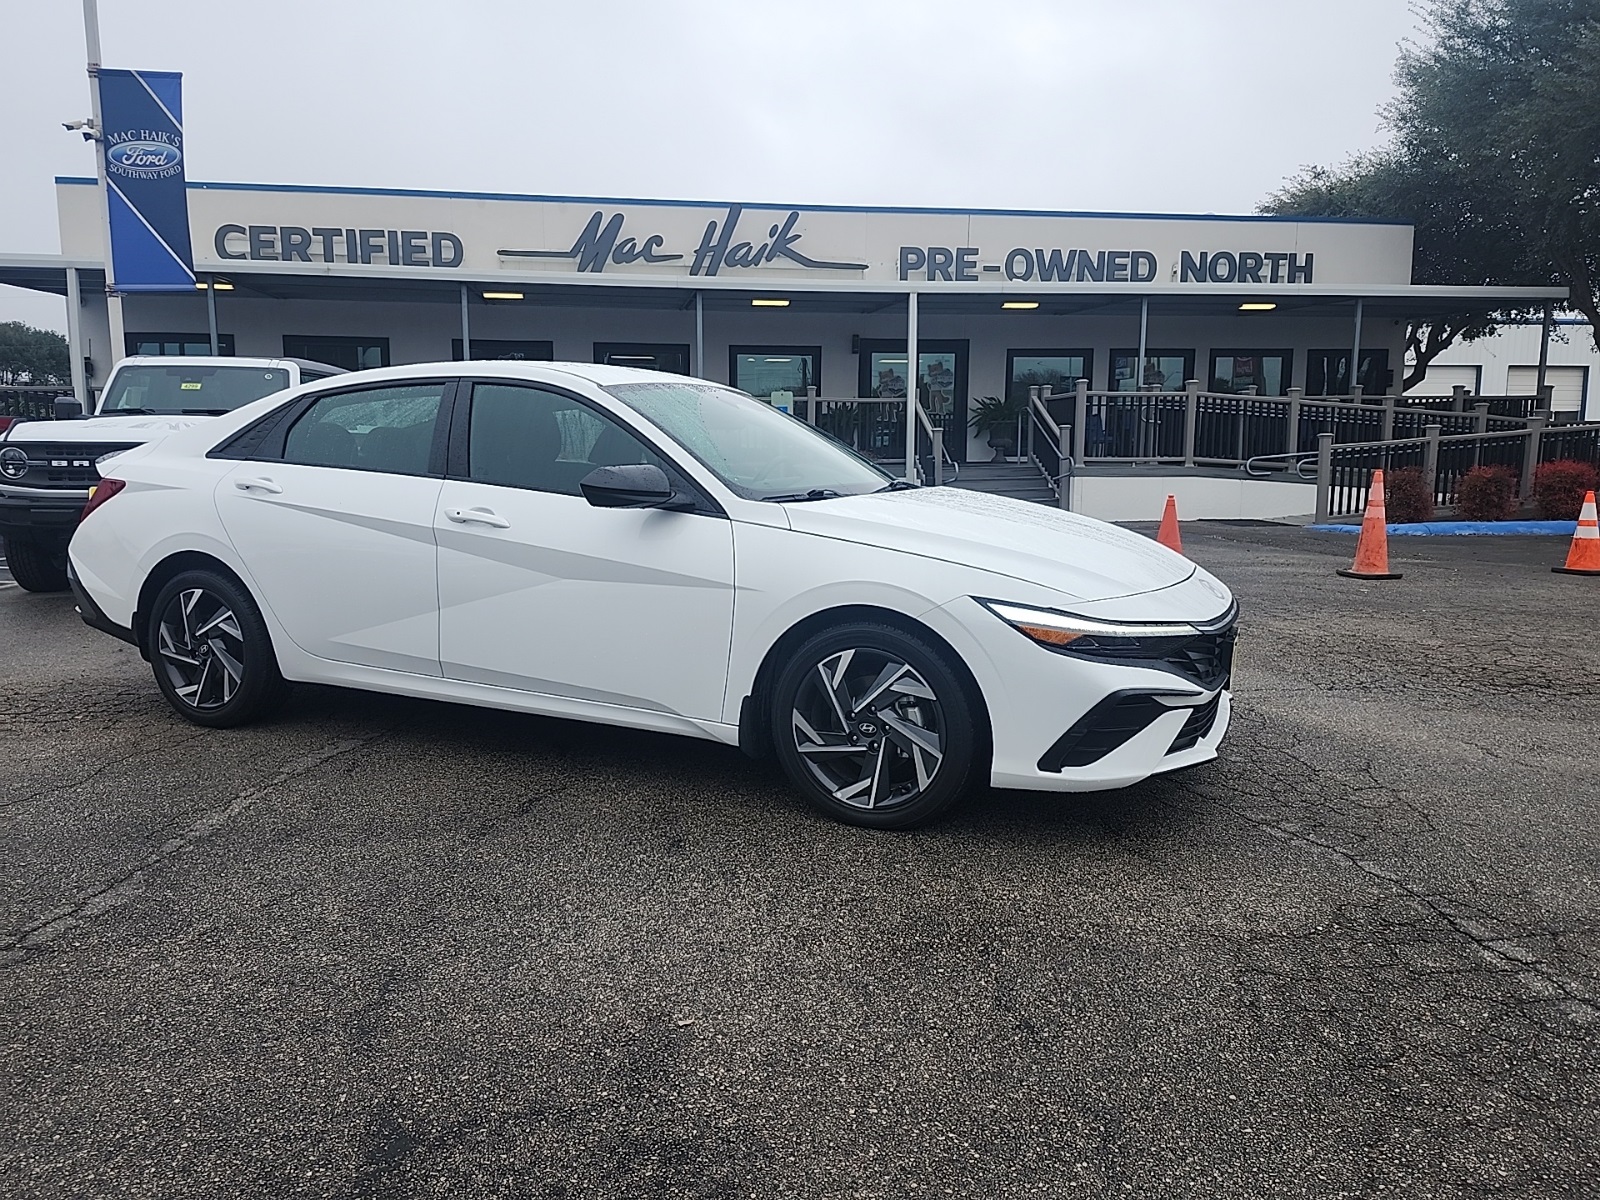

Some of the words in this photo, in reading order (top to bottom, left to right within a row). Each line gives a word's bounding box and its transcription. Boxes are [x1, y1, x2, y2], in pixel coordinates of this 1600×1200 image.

[107, 130, 136, 145] MAC
[140, 130, 181, 147] HAIK'S
[122, 145, 168, 165] Ford
[109, 164, 159, 179] SOUTHWAY
[160, 165, 181, 179] FORD
[214, 223, 464, 268] CERTIFIED
[497, 211, 683, 272] Mac
[688, 203, 869, 277] Haik
[899, 246, 1158, 283] PRE-OWNED
[1179, 250, 1314, 284] NORTH
